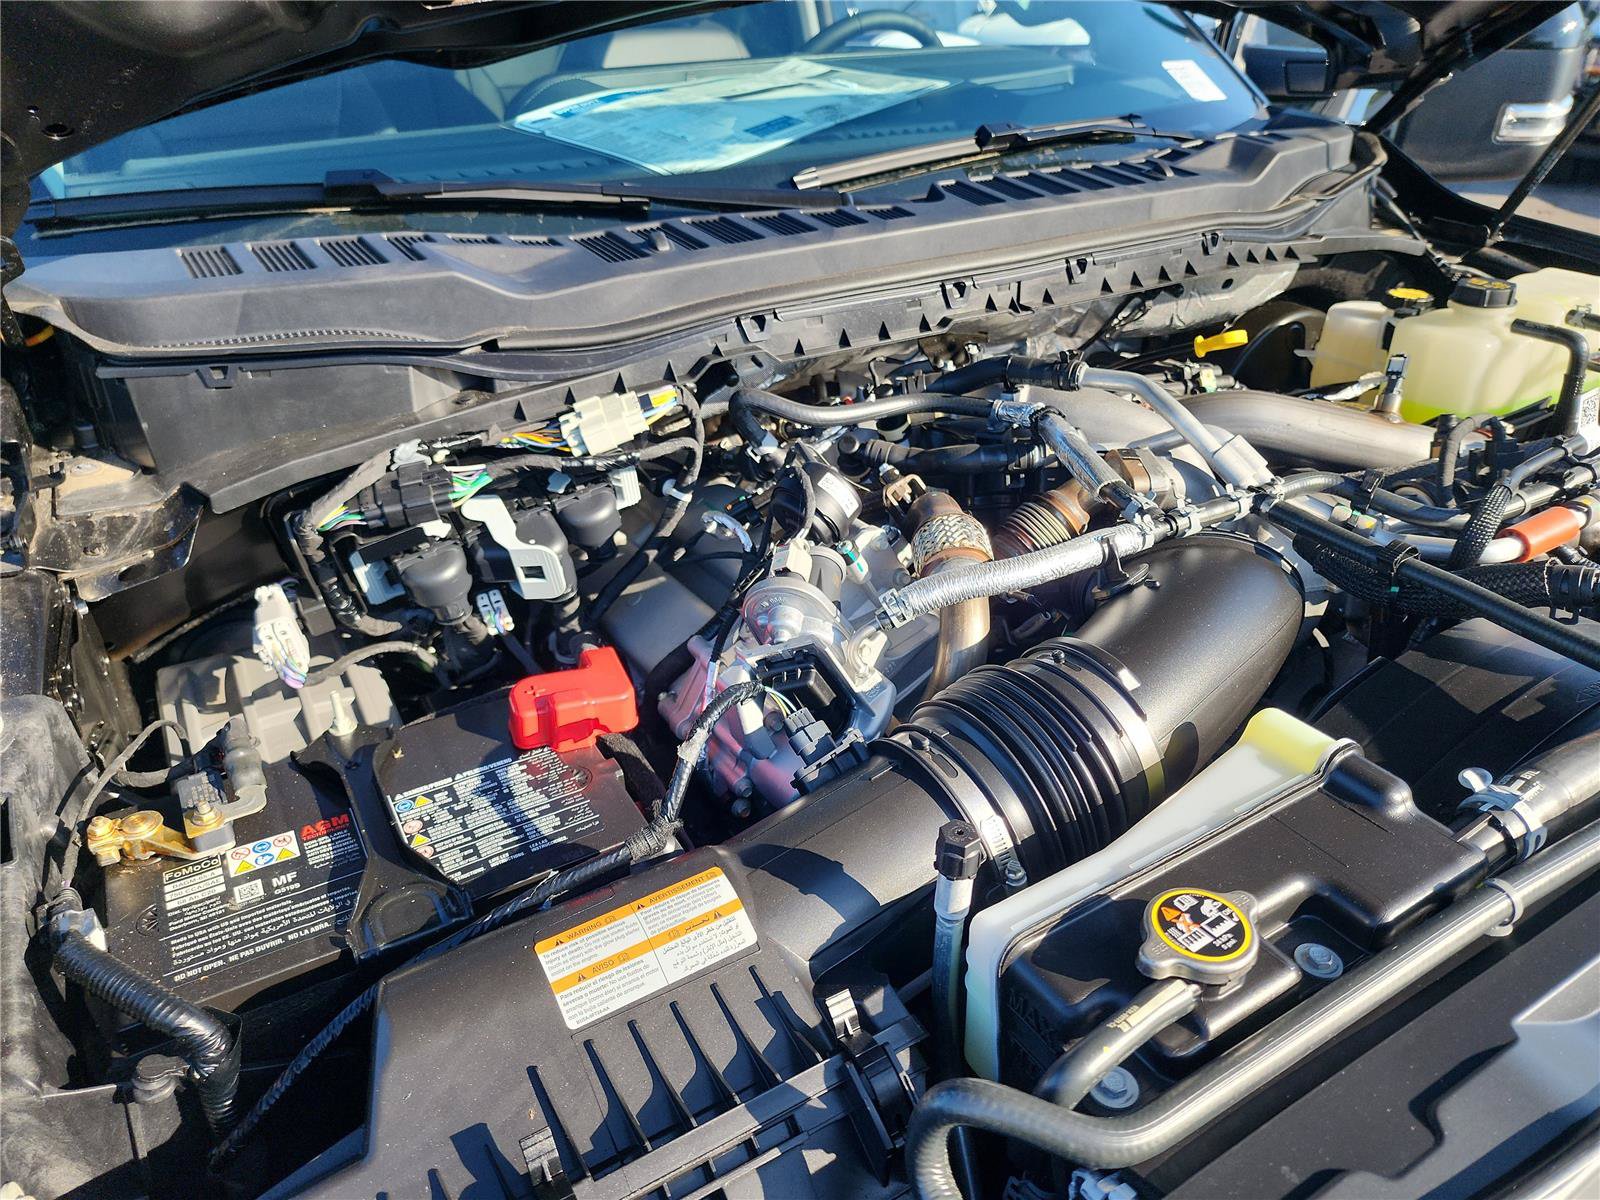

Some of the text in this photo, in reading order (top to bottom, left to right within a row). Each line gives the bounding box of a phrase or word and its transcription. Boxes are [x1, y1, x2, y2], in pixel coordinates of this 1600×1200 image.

[300, 814, 349, 838] AGM
[166, 859, 218, 880] FoMoCo
[272, 872, 297, 887] MF
[650, 877, 704, 903] AVERTISSEMENT
[241, 908, 265, 920] imported
[567, 921, 602, 940] WARNING
[175, 973, 185, 981] DO
[187, 967, 202, 977] NOT
[203, 960, 225, 971] OPEN.
[229, 954, 239, 962] NE
[240, 949, 254, 958] PAS
[255, 939, 285, 952] OUVRIR.
[310, 922, 331, 933] ABRA.
[551, 946, 568, 956] reduce
[592, 960, 615, 974] AVISO
[560, 992, 573, 1000] Para
[573, 983, 591, 994] reducir
[598, 973, 615, 982] riesgo
